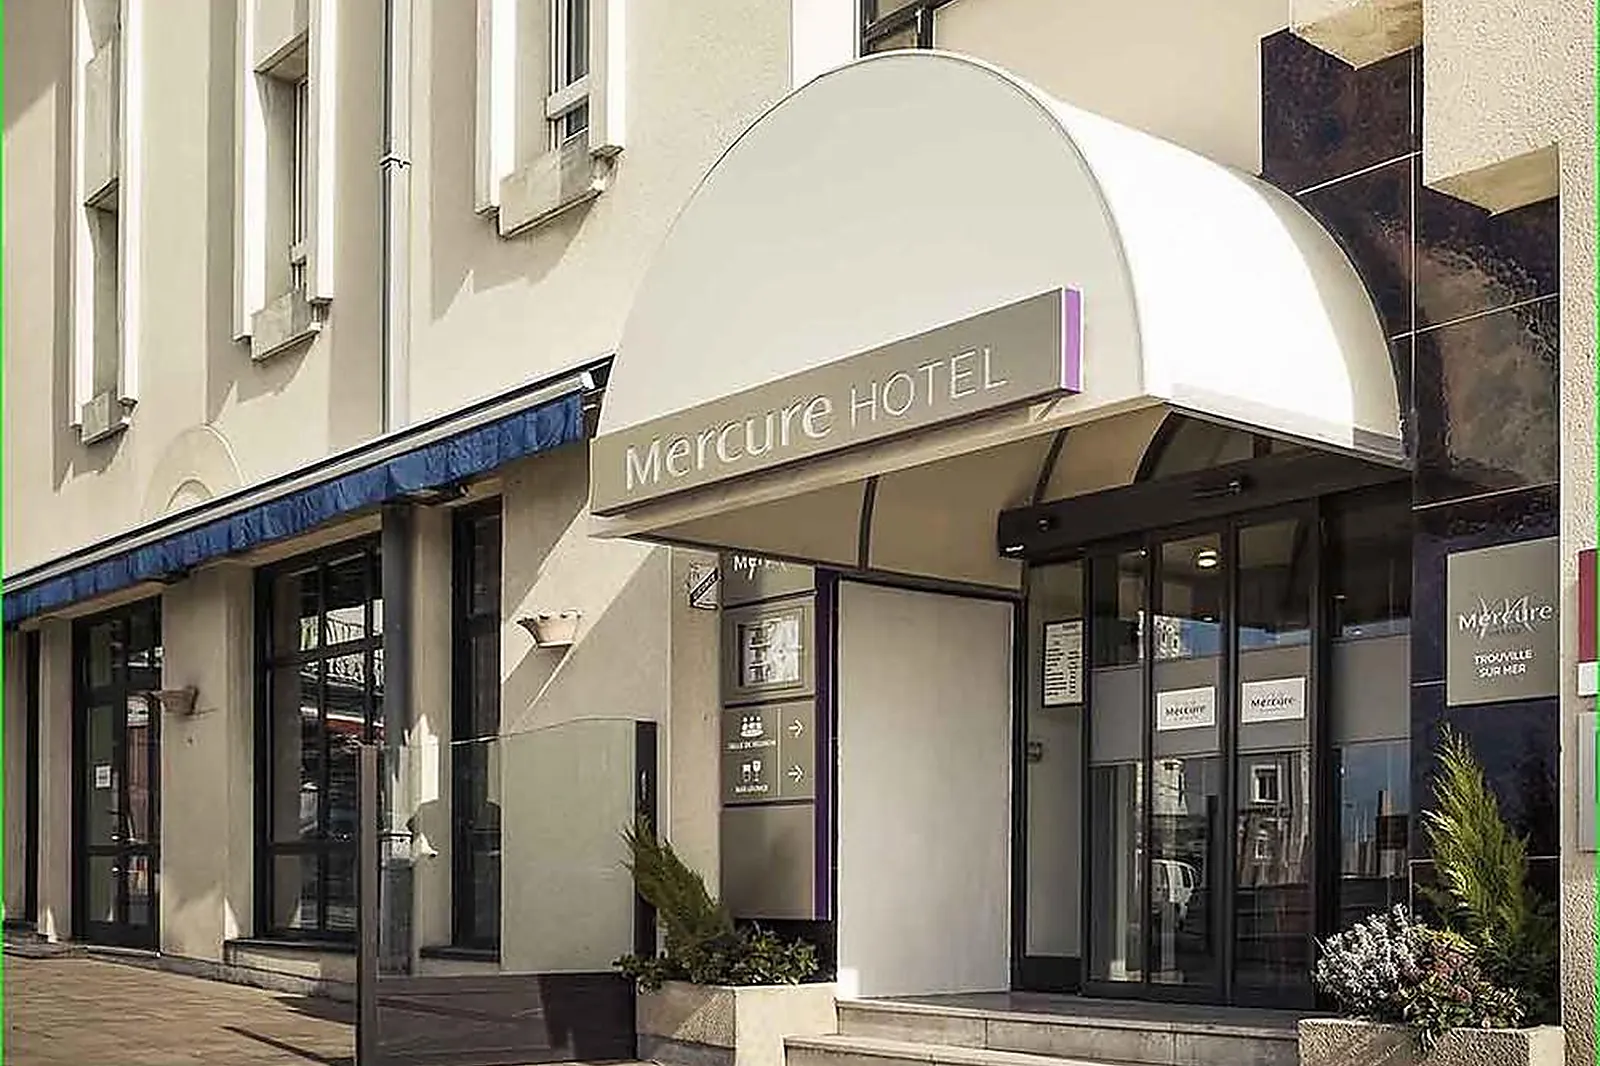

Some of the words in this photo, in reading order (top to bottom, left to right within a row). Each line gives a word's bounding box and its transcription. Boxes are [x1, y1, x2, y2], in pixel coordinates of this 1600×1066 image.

[625, 393, 833, 490] Mercure
[850, 346, 1008, 427] HOTEL
[1459, 605, 1553, 630] Mercure
[1474, 649, 1533, 665] TROUVILLE
[1478, 667, 1500, 678] SUR
[1503, 663, 1526, 675] MER
